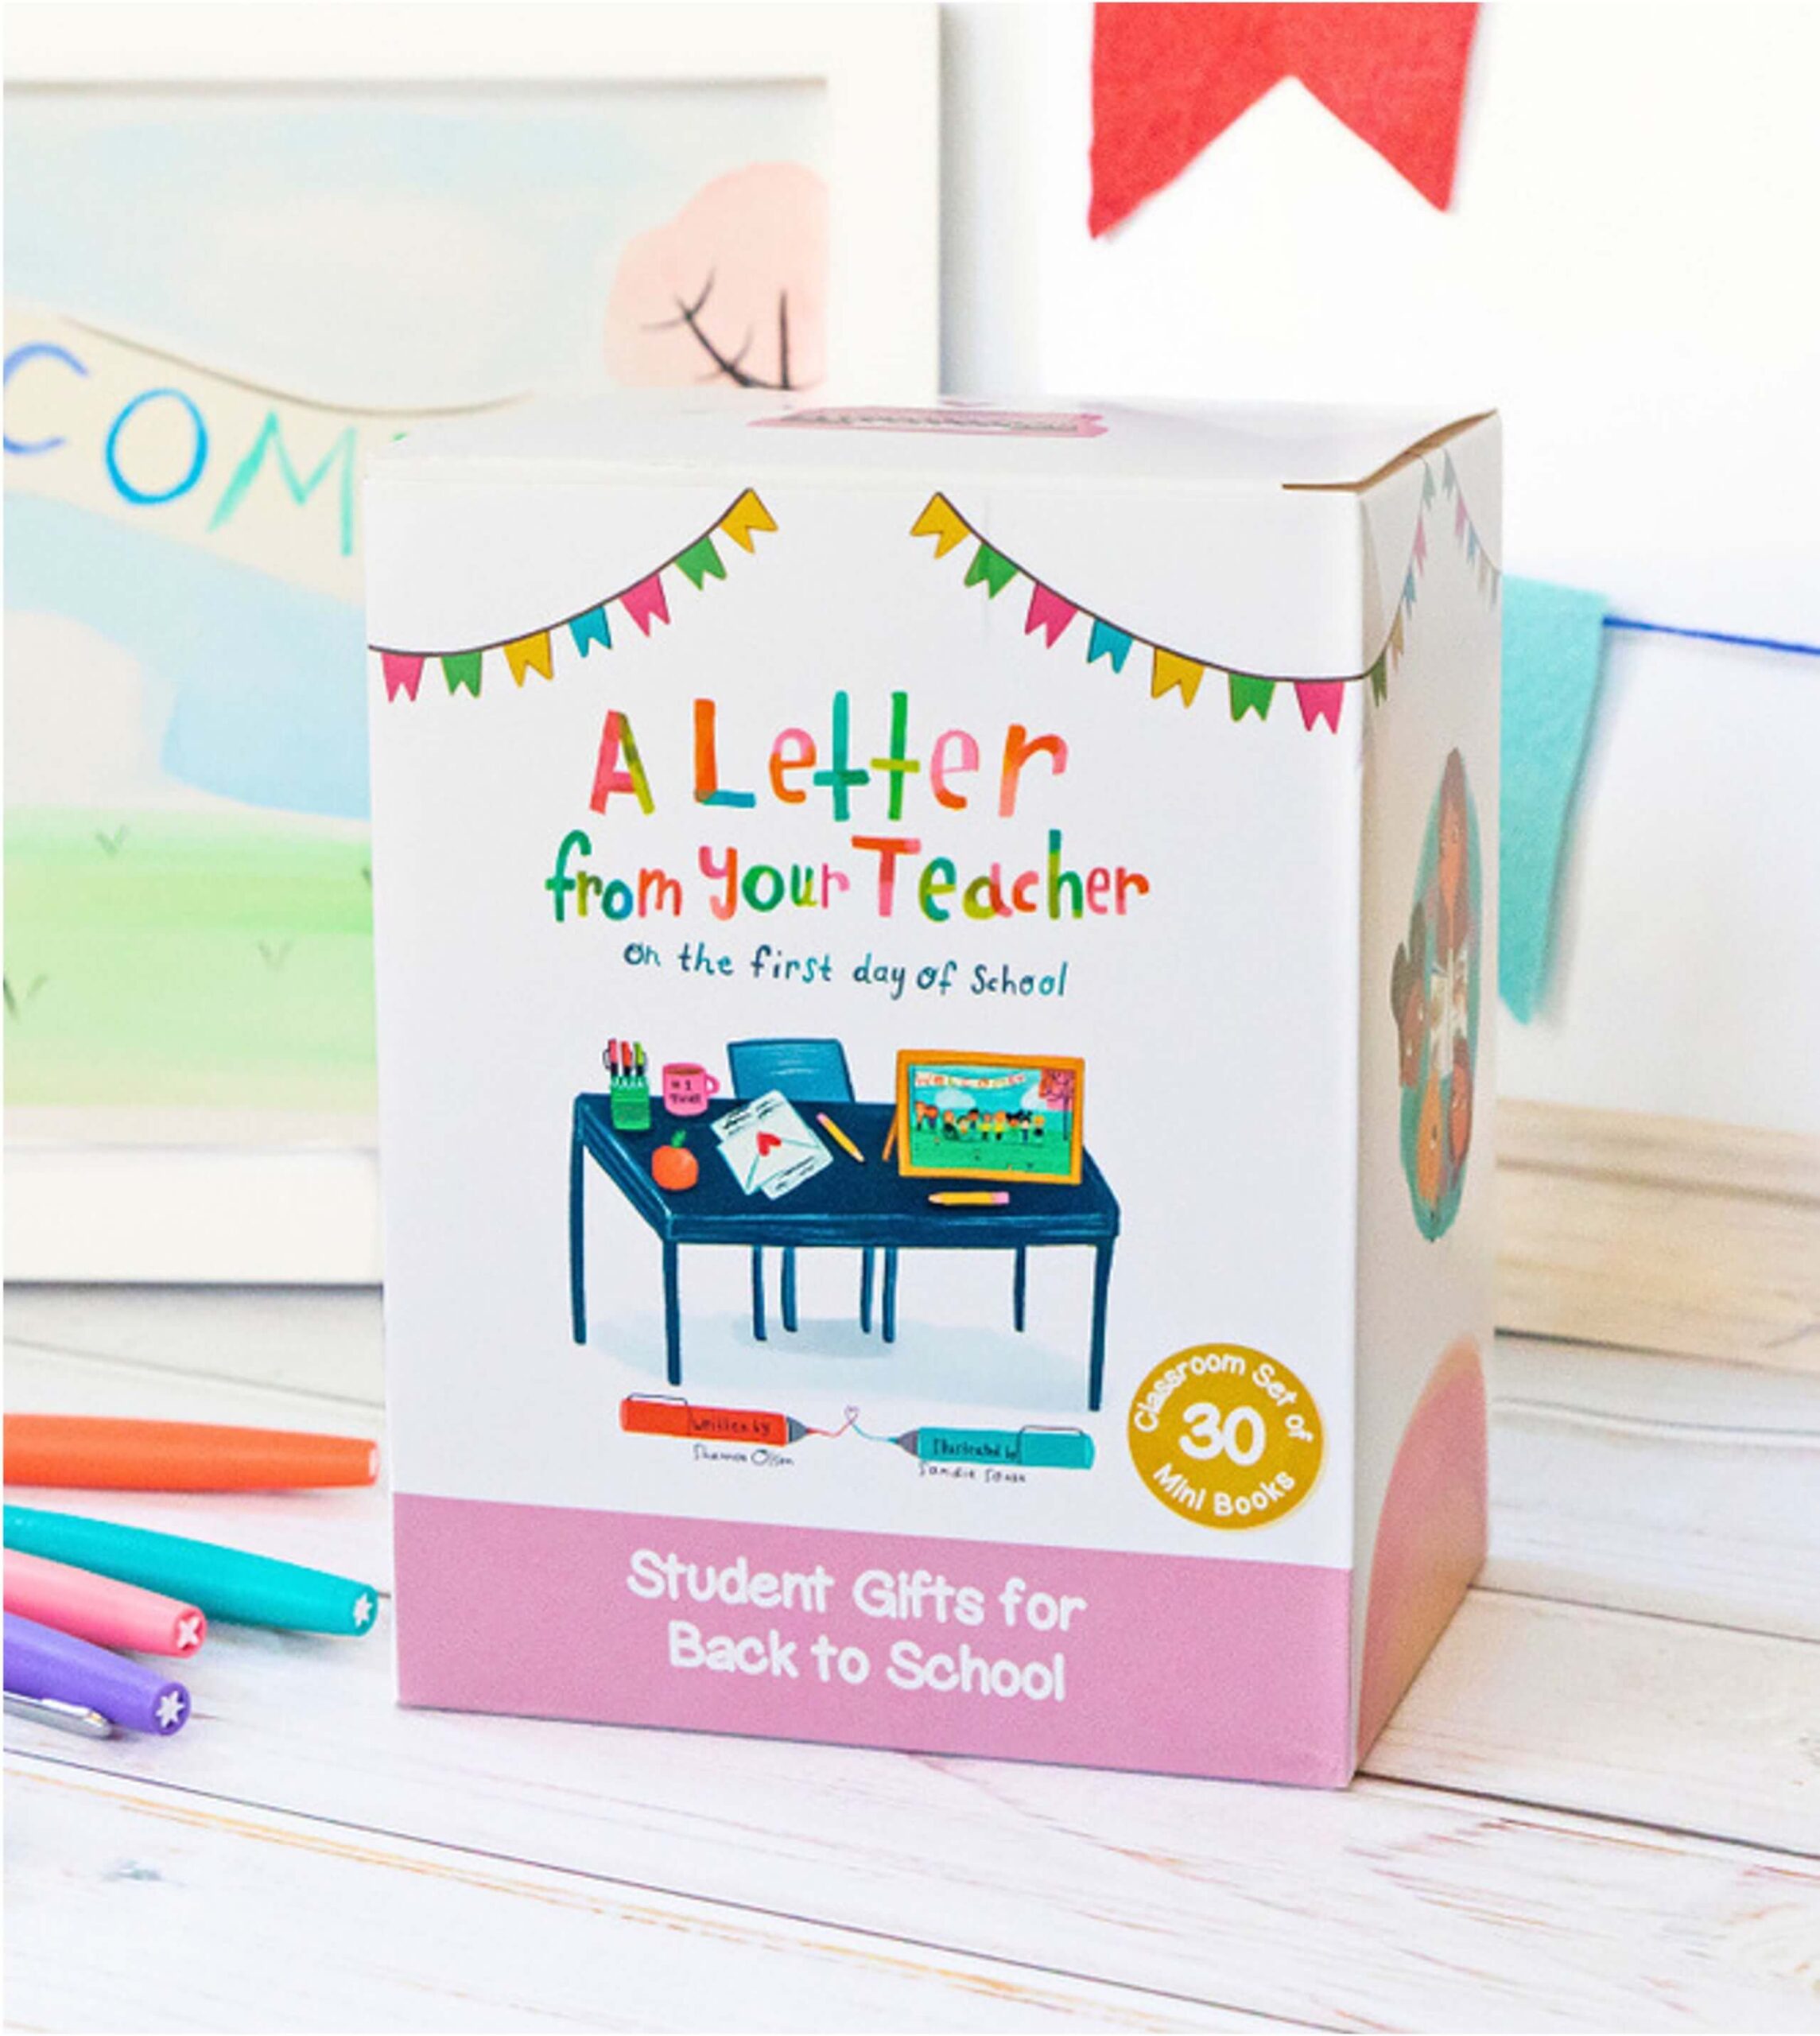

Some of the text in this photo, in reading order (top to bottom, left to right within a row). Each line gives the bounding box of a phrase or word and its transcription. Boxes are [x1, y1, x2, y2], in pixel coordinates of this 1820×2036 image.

[3, 340, 407, 558] COM
[589, 690, 1069, 822] A Letter
[545, 830, 683, 923] from
[851, 829, 1151, 923] Teacher
[678, 942, 734, 977] the
[751, 944, 832, 984] first
[852, 953, 906, 1001] day
[916, 959, 958, 996] of
[969, 960, 1069, 997] School
[1134, 1354, 1314, 1443] Classroom Set of
[1178, 1401, 1267, 1467] 30
[1153, 1463, 1295, 1517] Mini Books
[627, 1548, 1089, 1631] Student Gifts for
[667, 1618, 1066, 1703] Back to School
